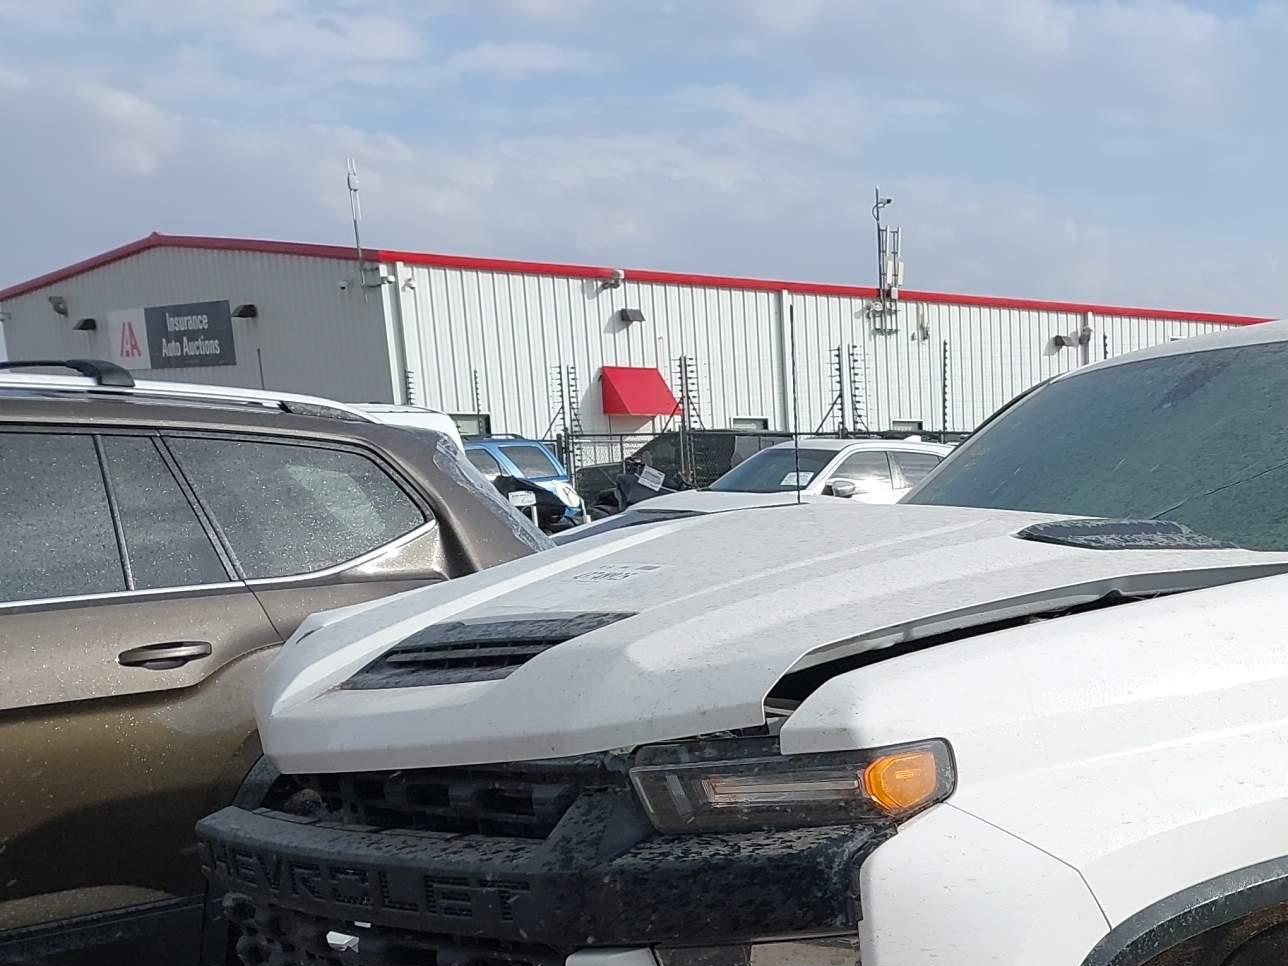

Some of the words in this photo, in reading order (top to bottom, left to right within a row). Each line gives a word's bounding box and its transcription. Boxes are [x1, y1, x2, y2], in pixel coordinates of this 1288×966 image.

[165, 312, 209, 332] Insurance
[162, 338, 181, 357] Auto
[183, 335, 220, 356] Auctions
